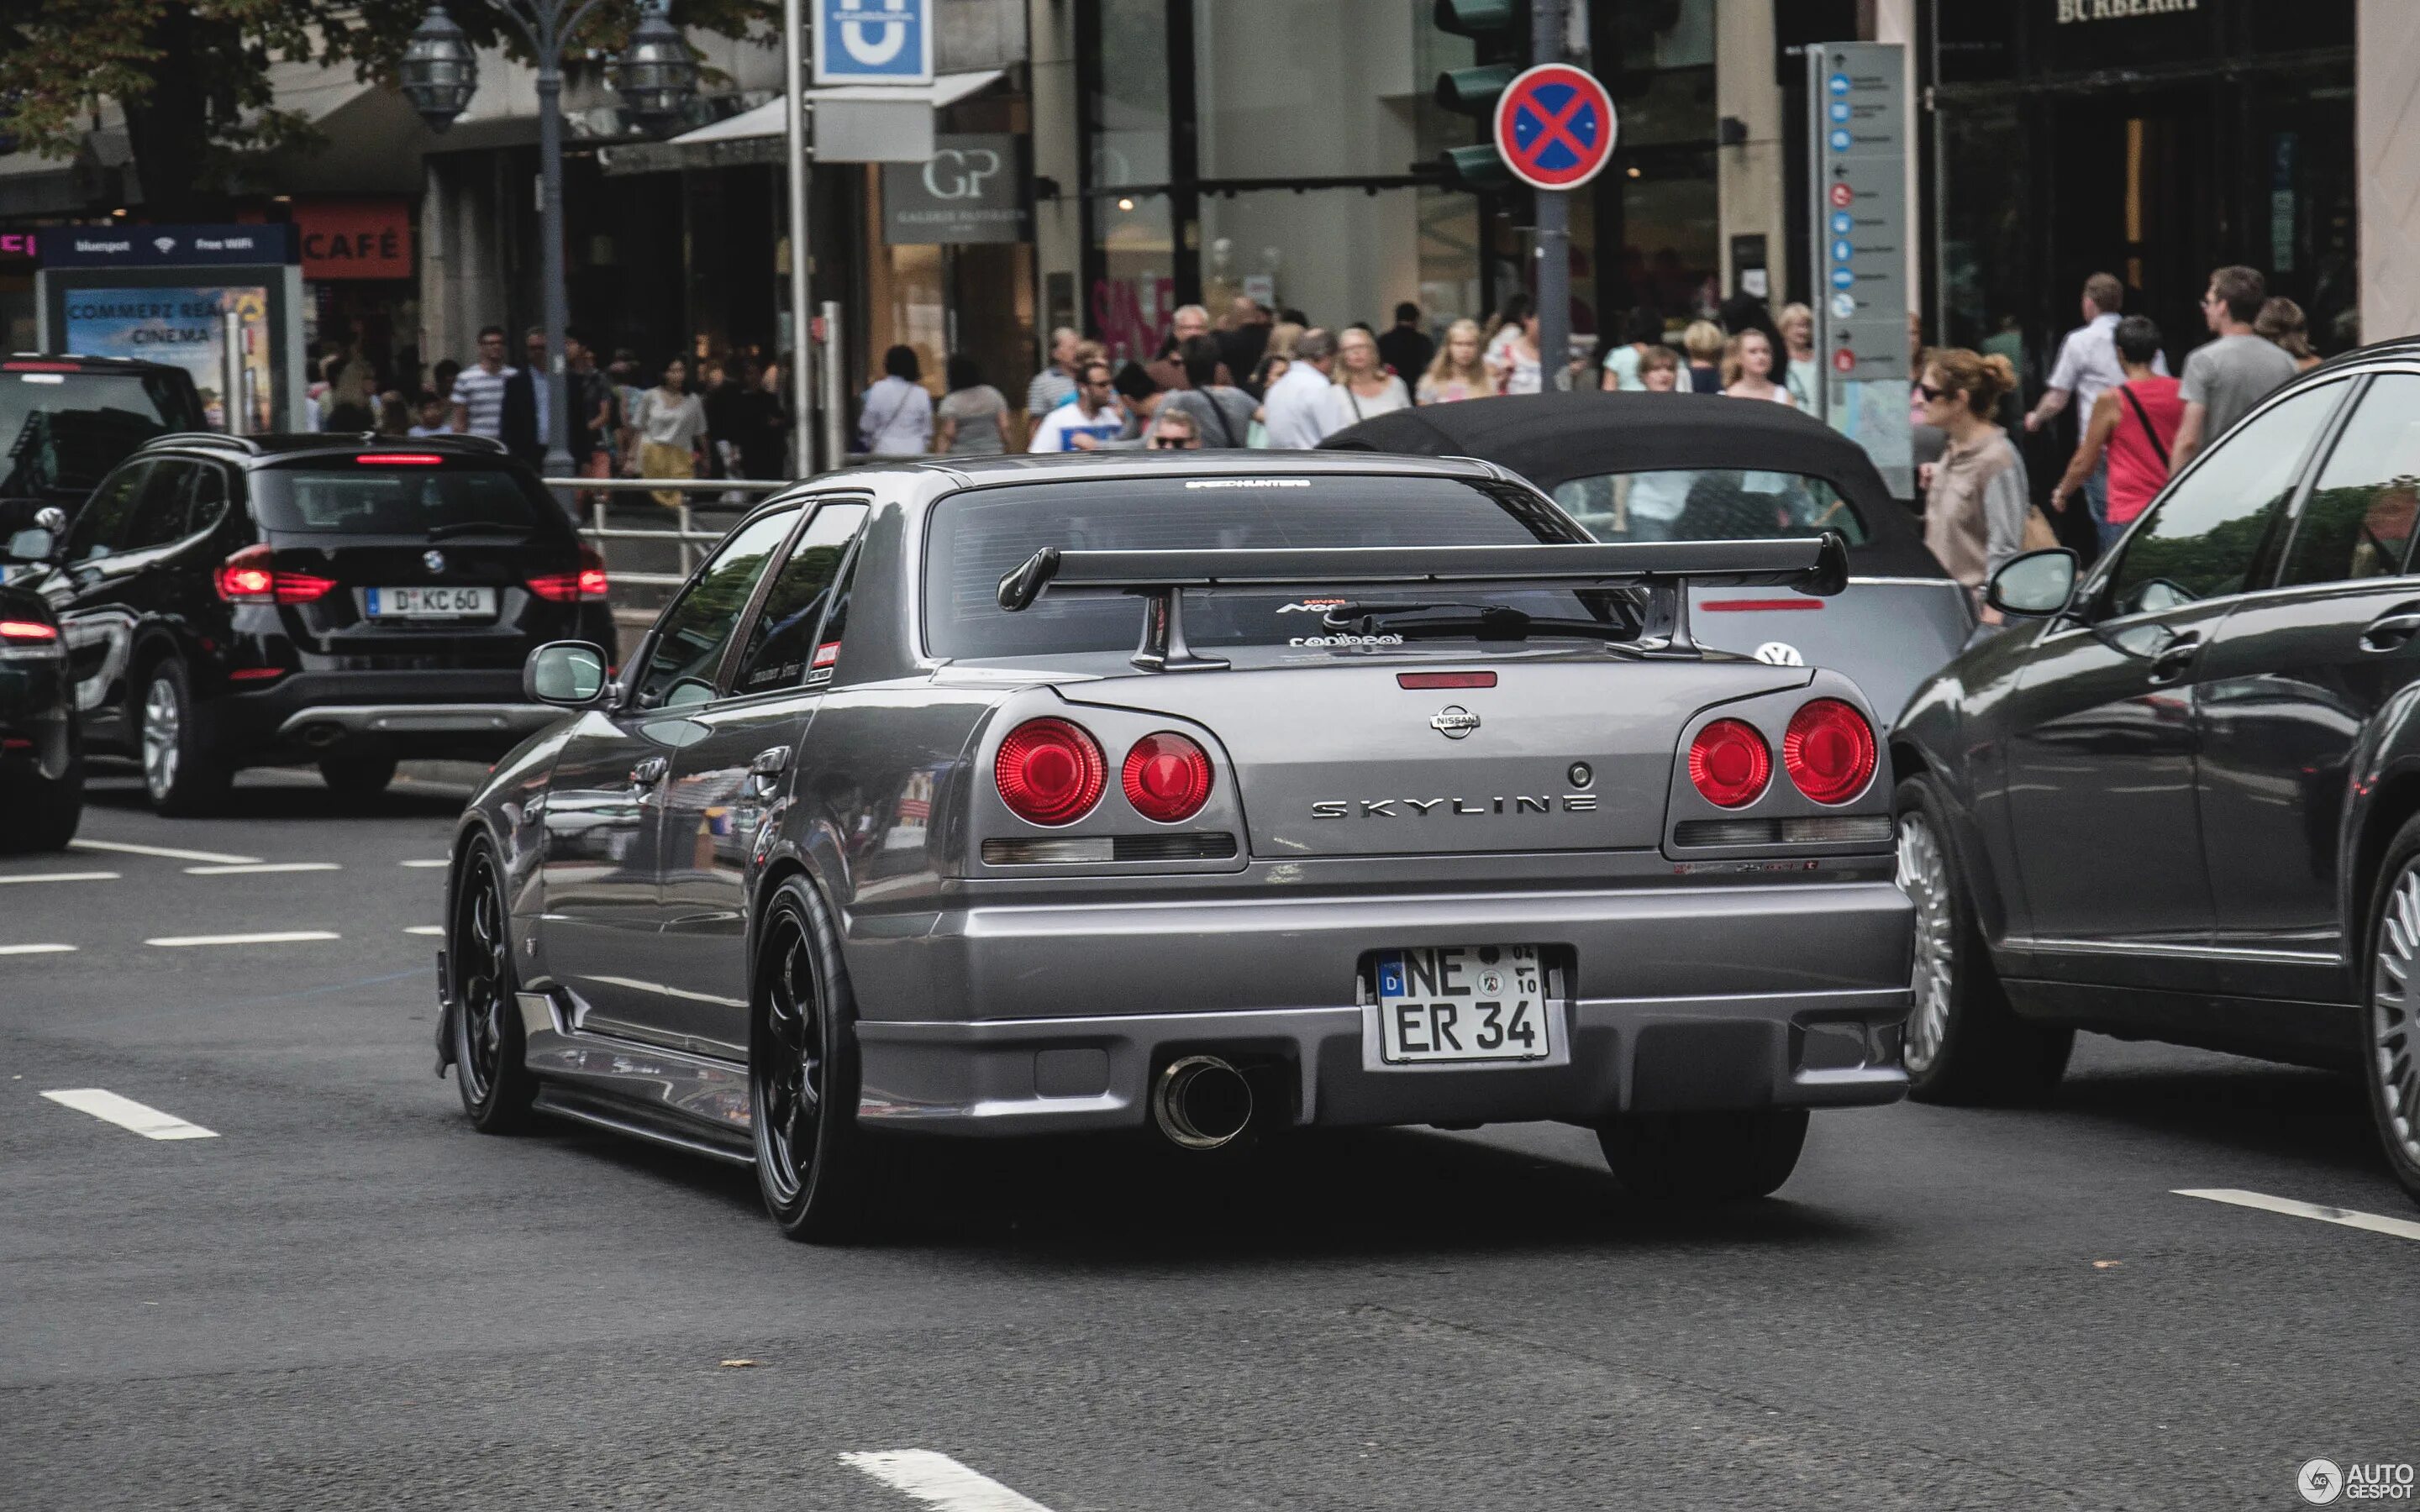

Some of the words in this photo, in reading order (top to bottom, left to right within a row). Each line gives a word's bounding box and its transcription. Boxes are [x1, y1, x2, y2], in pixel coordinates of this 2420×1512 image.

[923, 150, 1000, 198] GP
[304, 227, 399, 260] CAFÉ
[179, 302, 224, 318] REA
[133, 328, 209, 344] CINEMA
[424, 591, 450, 610] KC
[455, 591, 479, 610] 60
[1312, 795, 1597, 818] SKYLINE
[1403, 948, 1471, 997] NE
[1386, 977, 1397, 990] D
[1518, 979, 1537, 994] 10
[1397, 1003, 1463, 1052] ER
[1475, 1000, 1535, 1050] 34
